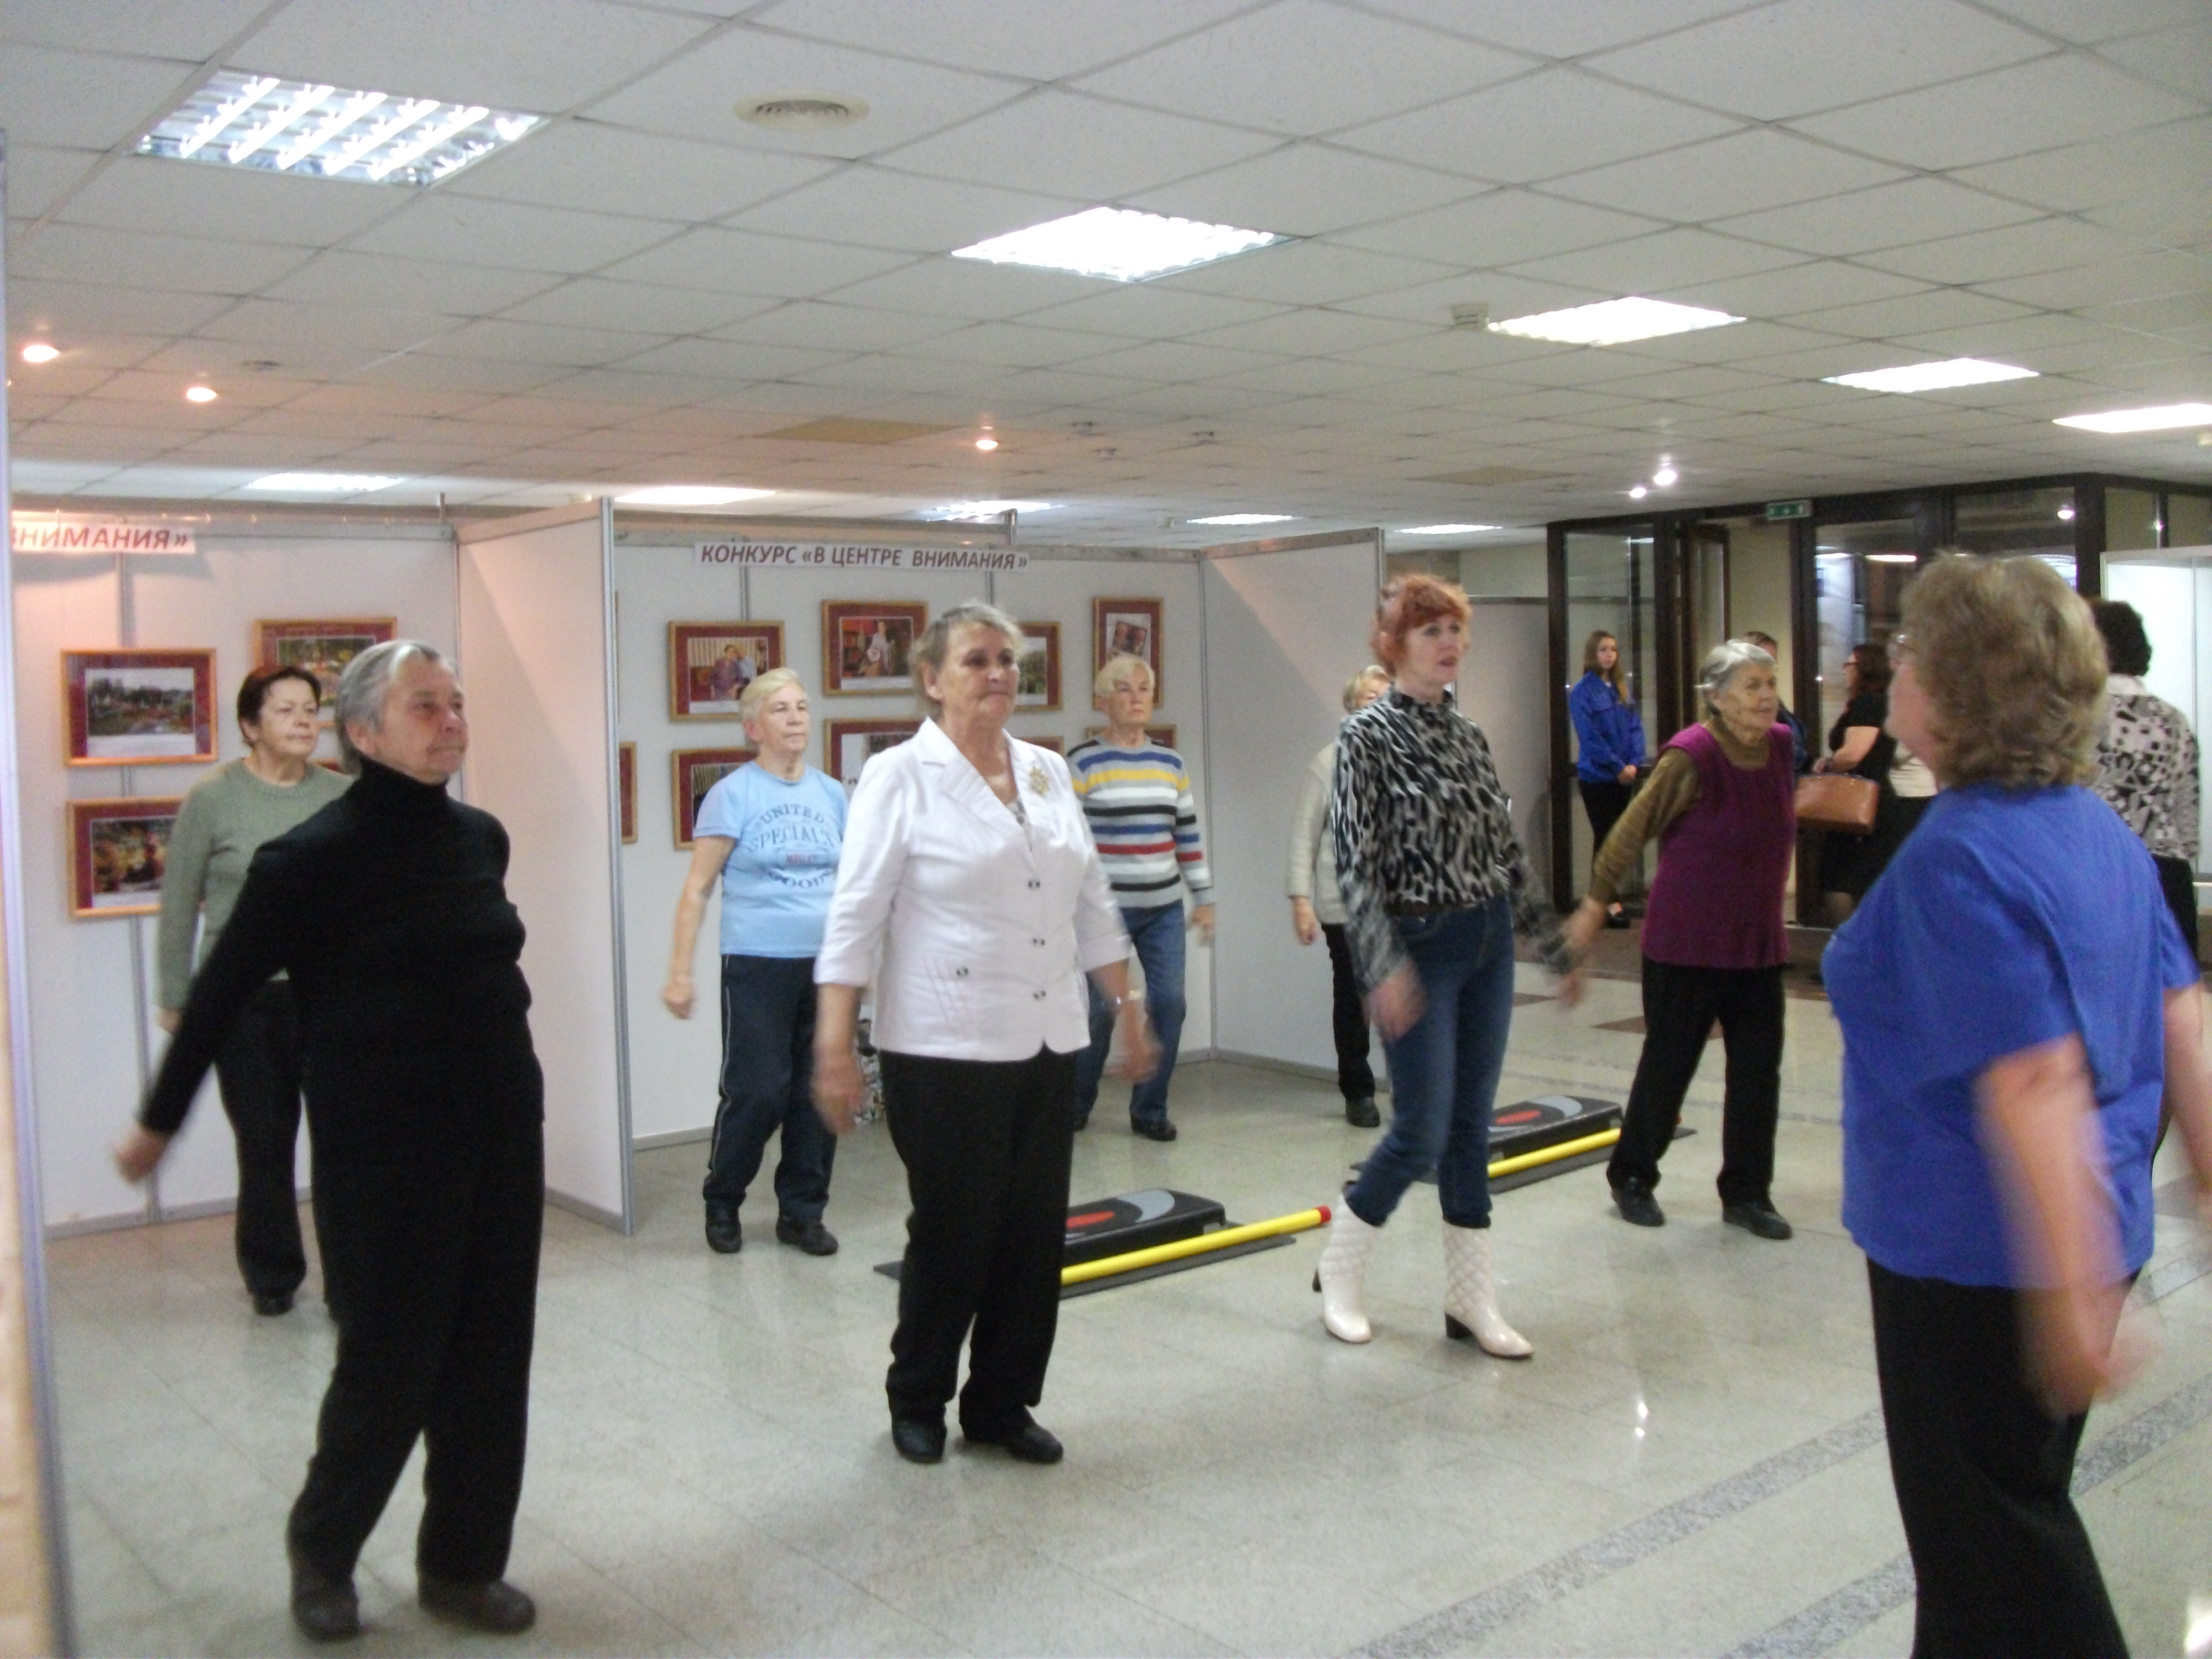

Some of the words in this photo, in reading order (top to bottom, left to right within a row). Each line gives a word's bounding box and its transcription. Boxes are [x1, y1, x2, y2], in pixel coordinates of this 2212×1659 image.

[701, 544, 797, 564] КОНКУРС
[802, 546, 825, 564] «В
[831, 547, 902, 567] ЦЕНТРЕ
[912, 550, 1027, 570] ВНИМАНИЯ»
[760, 804, 825, 824] UNITED
